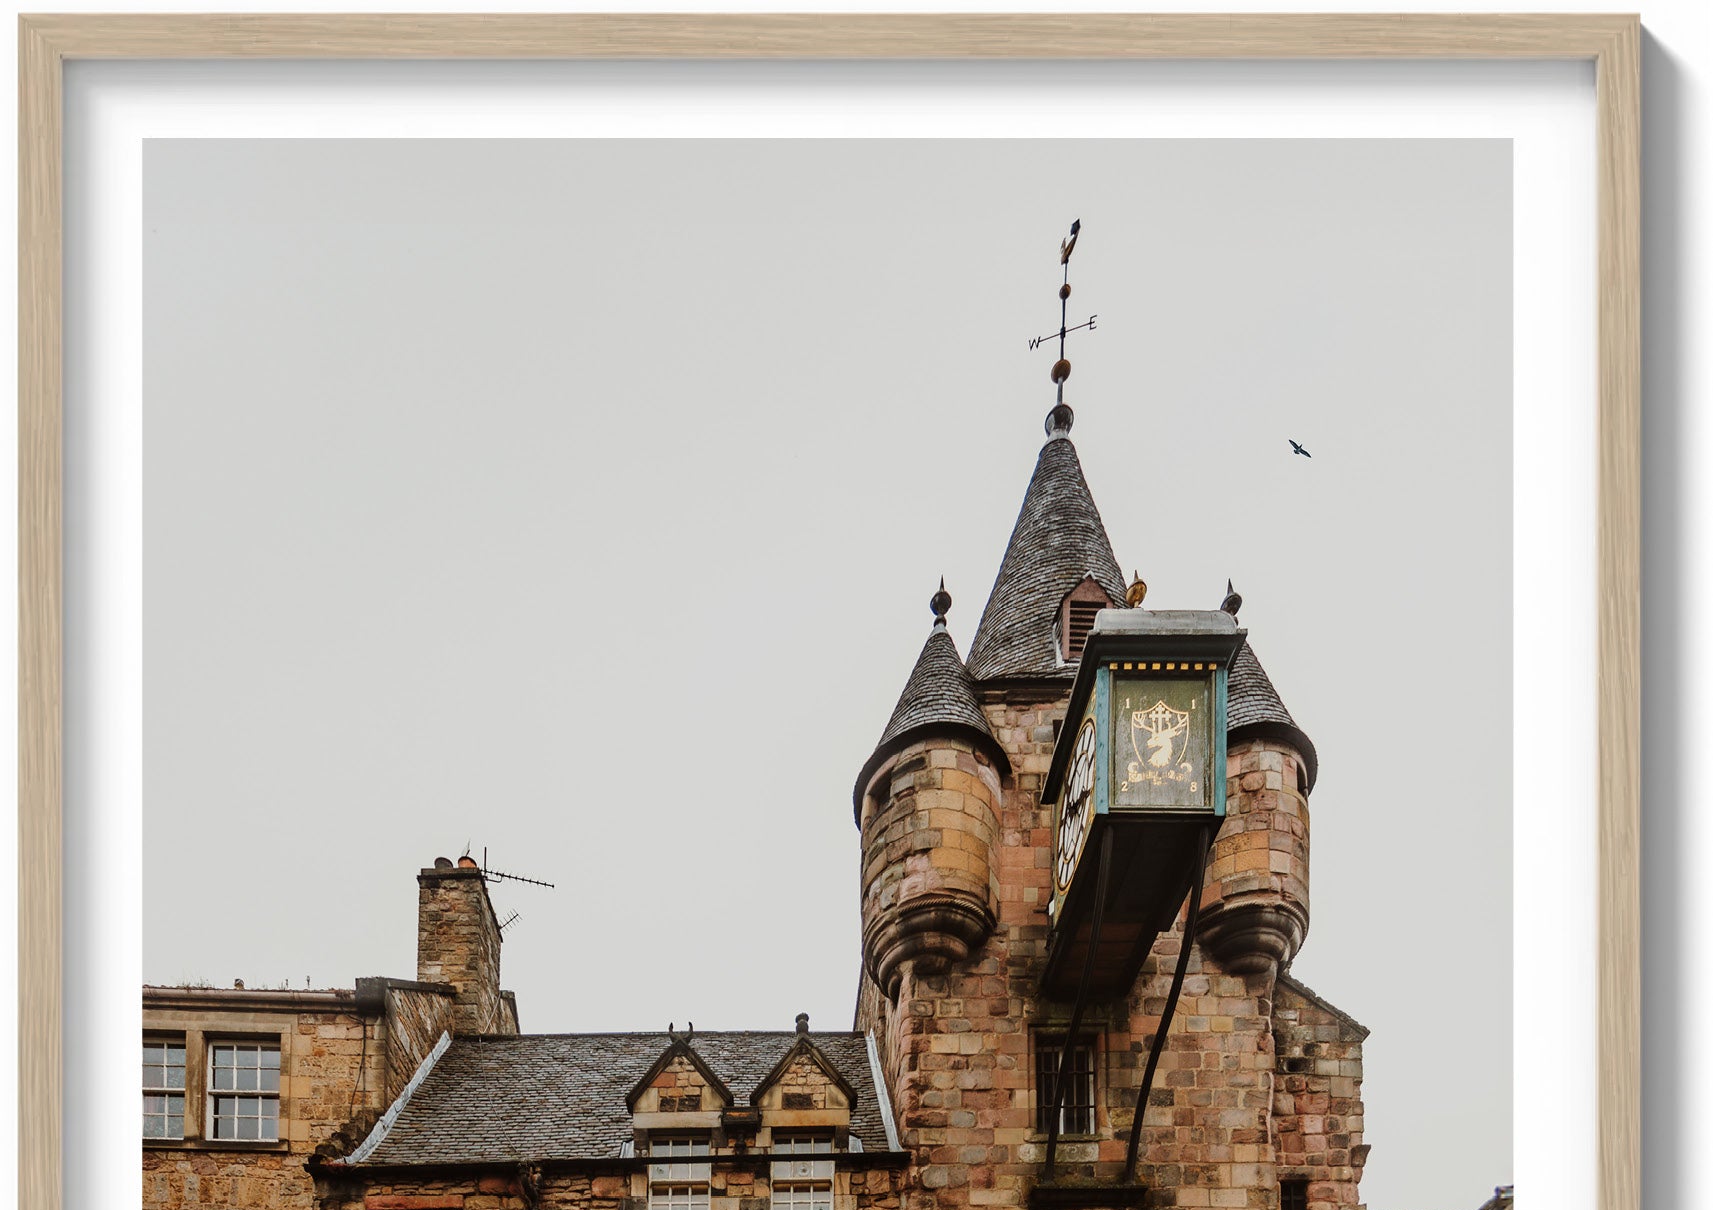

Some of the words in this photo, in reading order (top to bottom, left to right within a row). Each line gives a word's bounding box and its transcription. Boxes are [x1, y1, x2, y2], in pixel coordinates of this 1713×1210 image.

[1089, 314, 1098, 331] E
[1028, 336, 1041, 351] W
[1121, 781, 1128, 792] 2
[1190, 781, 1198, 792] 8
